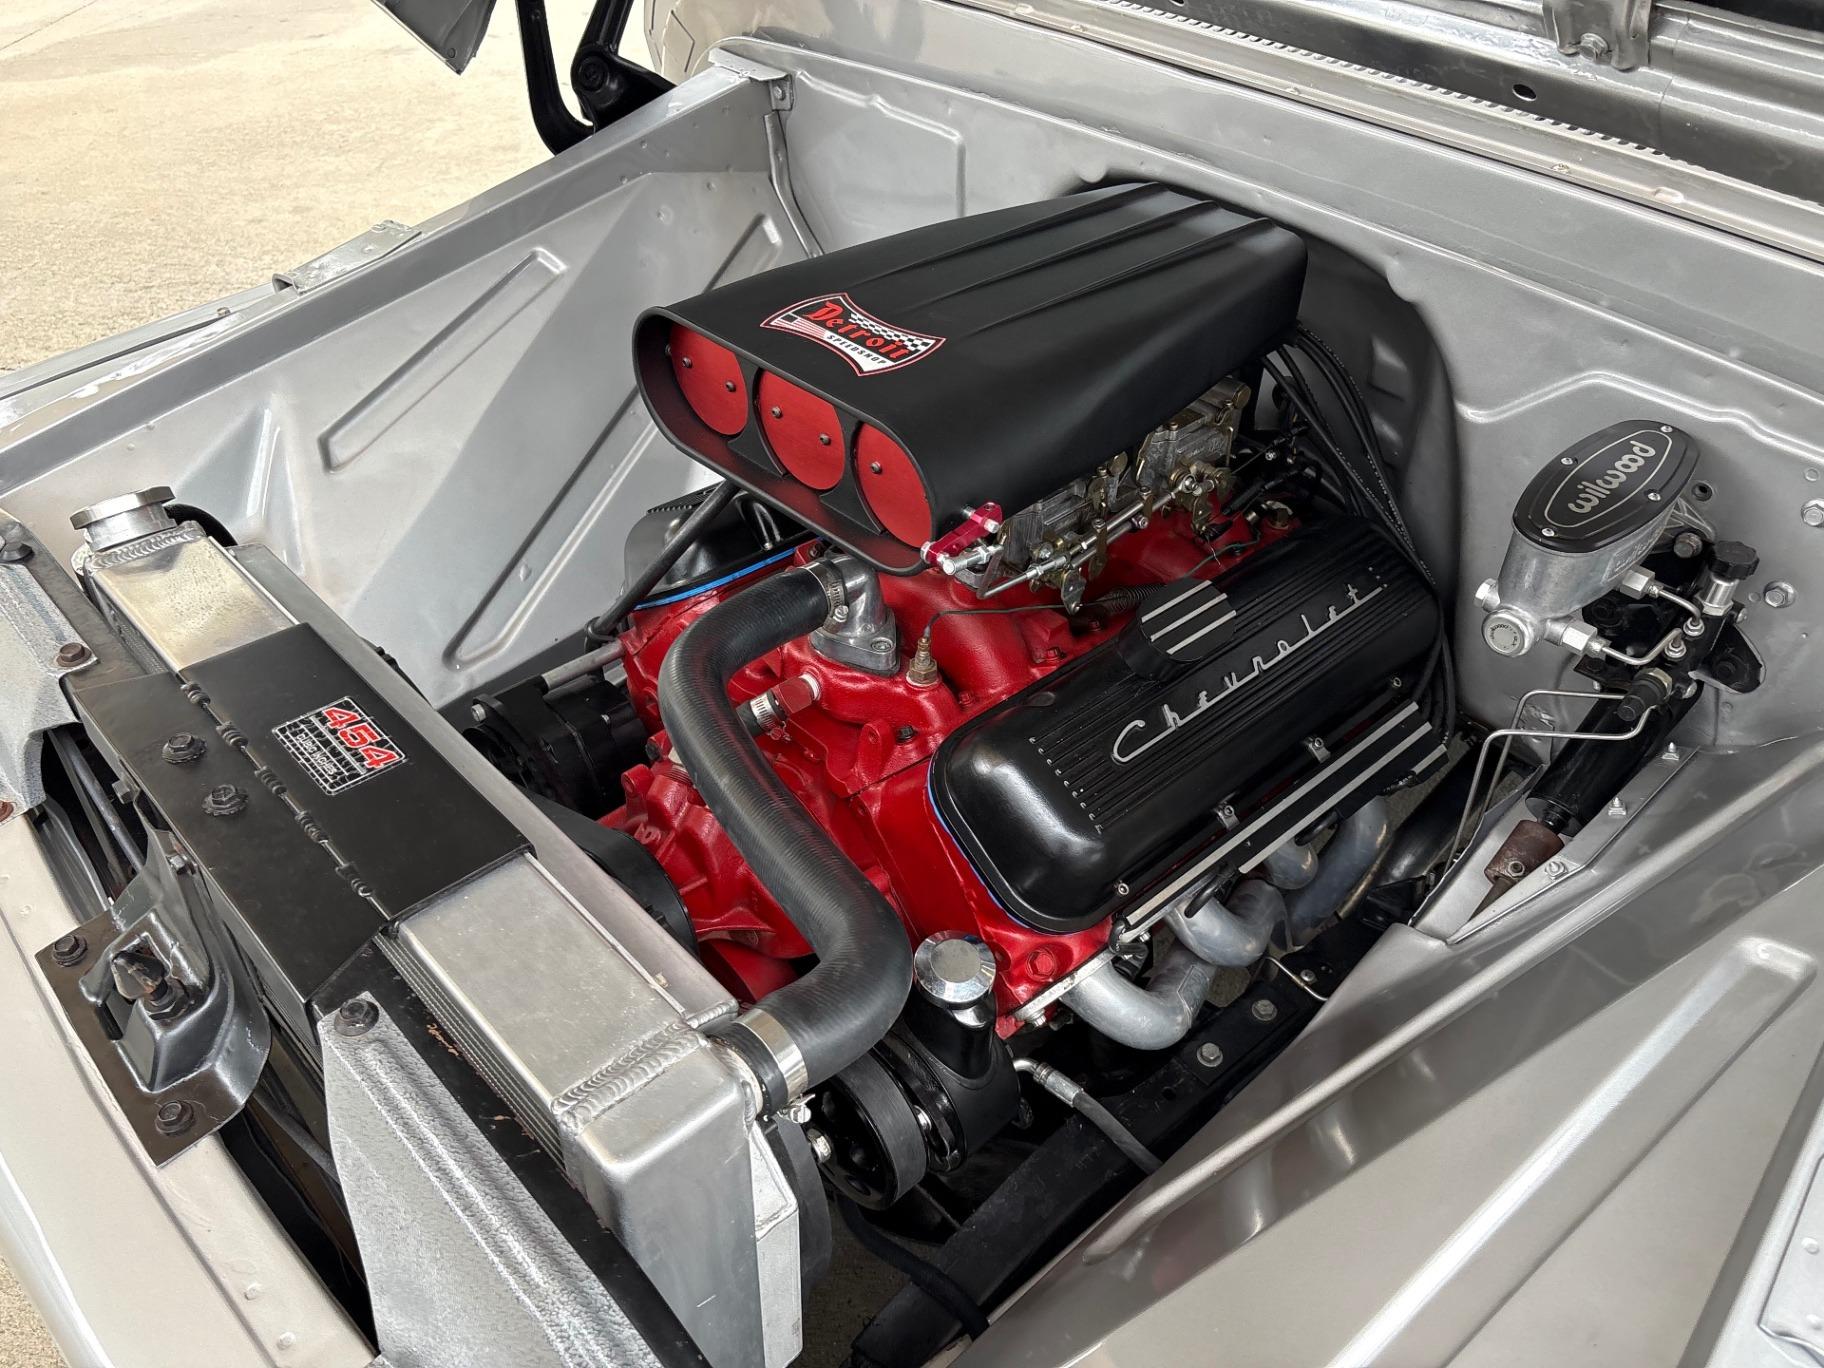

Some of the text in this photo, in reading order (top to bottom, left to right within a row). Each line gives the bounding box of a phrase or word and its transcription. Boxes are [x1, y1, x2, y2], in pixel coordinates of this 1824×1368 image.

[802, 301, 910, 359] Detroit
[826, 333, 888, 366] SPEEDSHOP
[1567, 440, 1657, 515] wilwood
[1112, 583, 1384, 763] Chevrolet
[296, 732, 339, 776] CUBIC INCHES
[322, 706, 400, 769] 454
